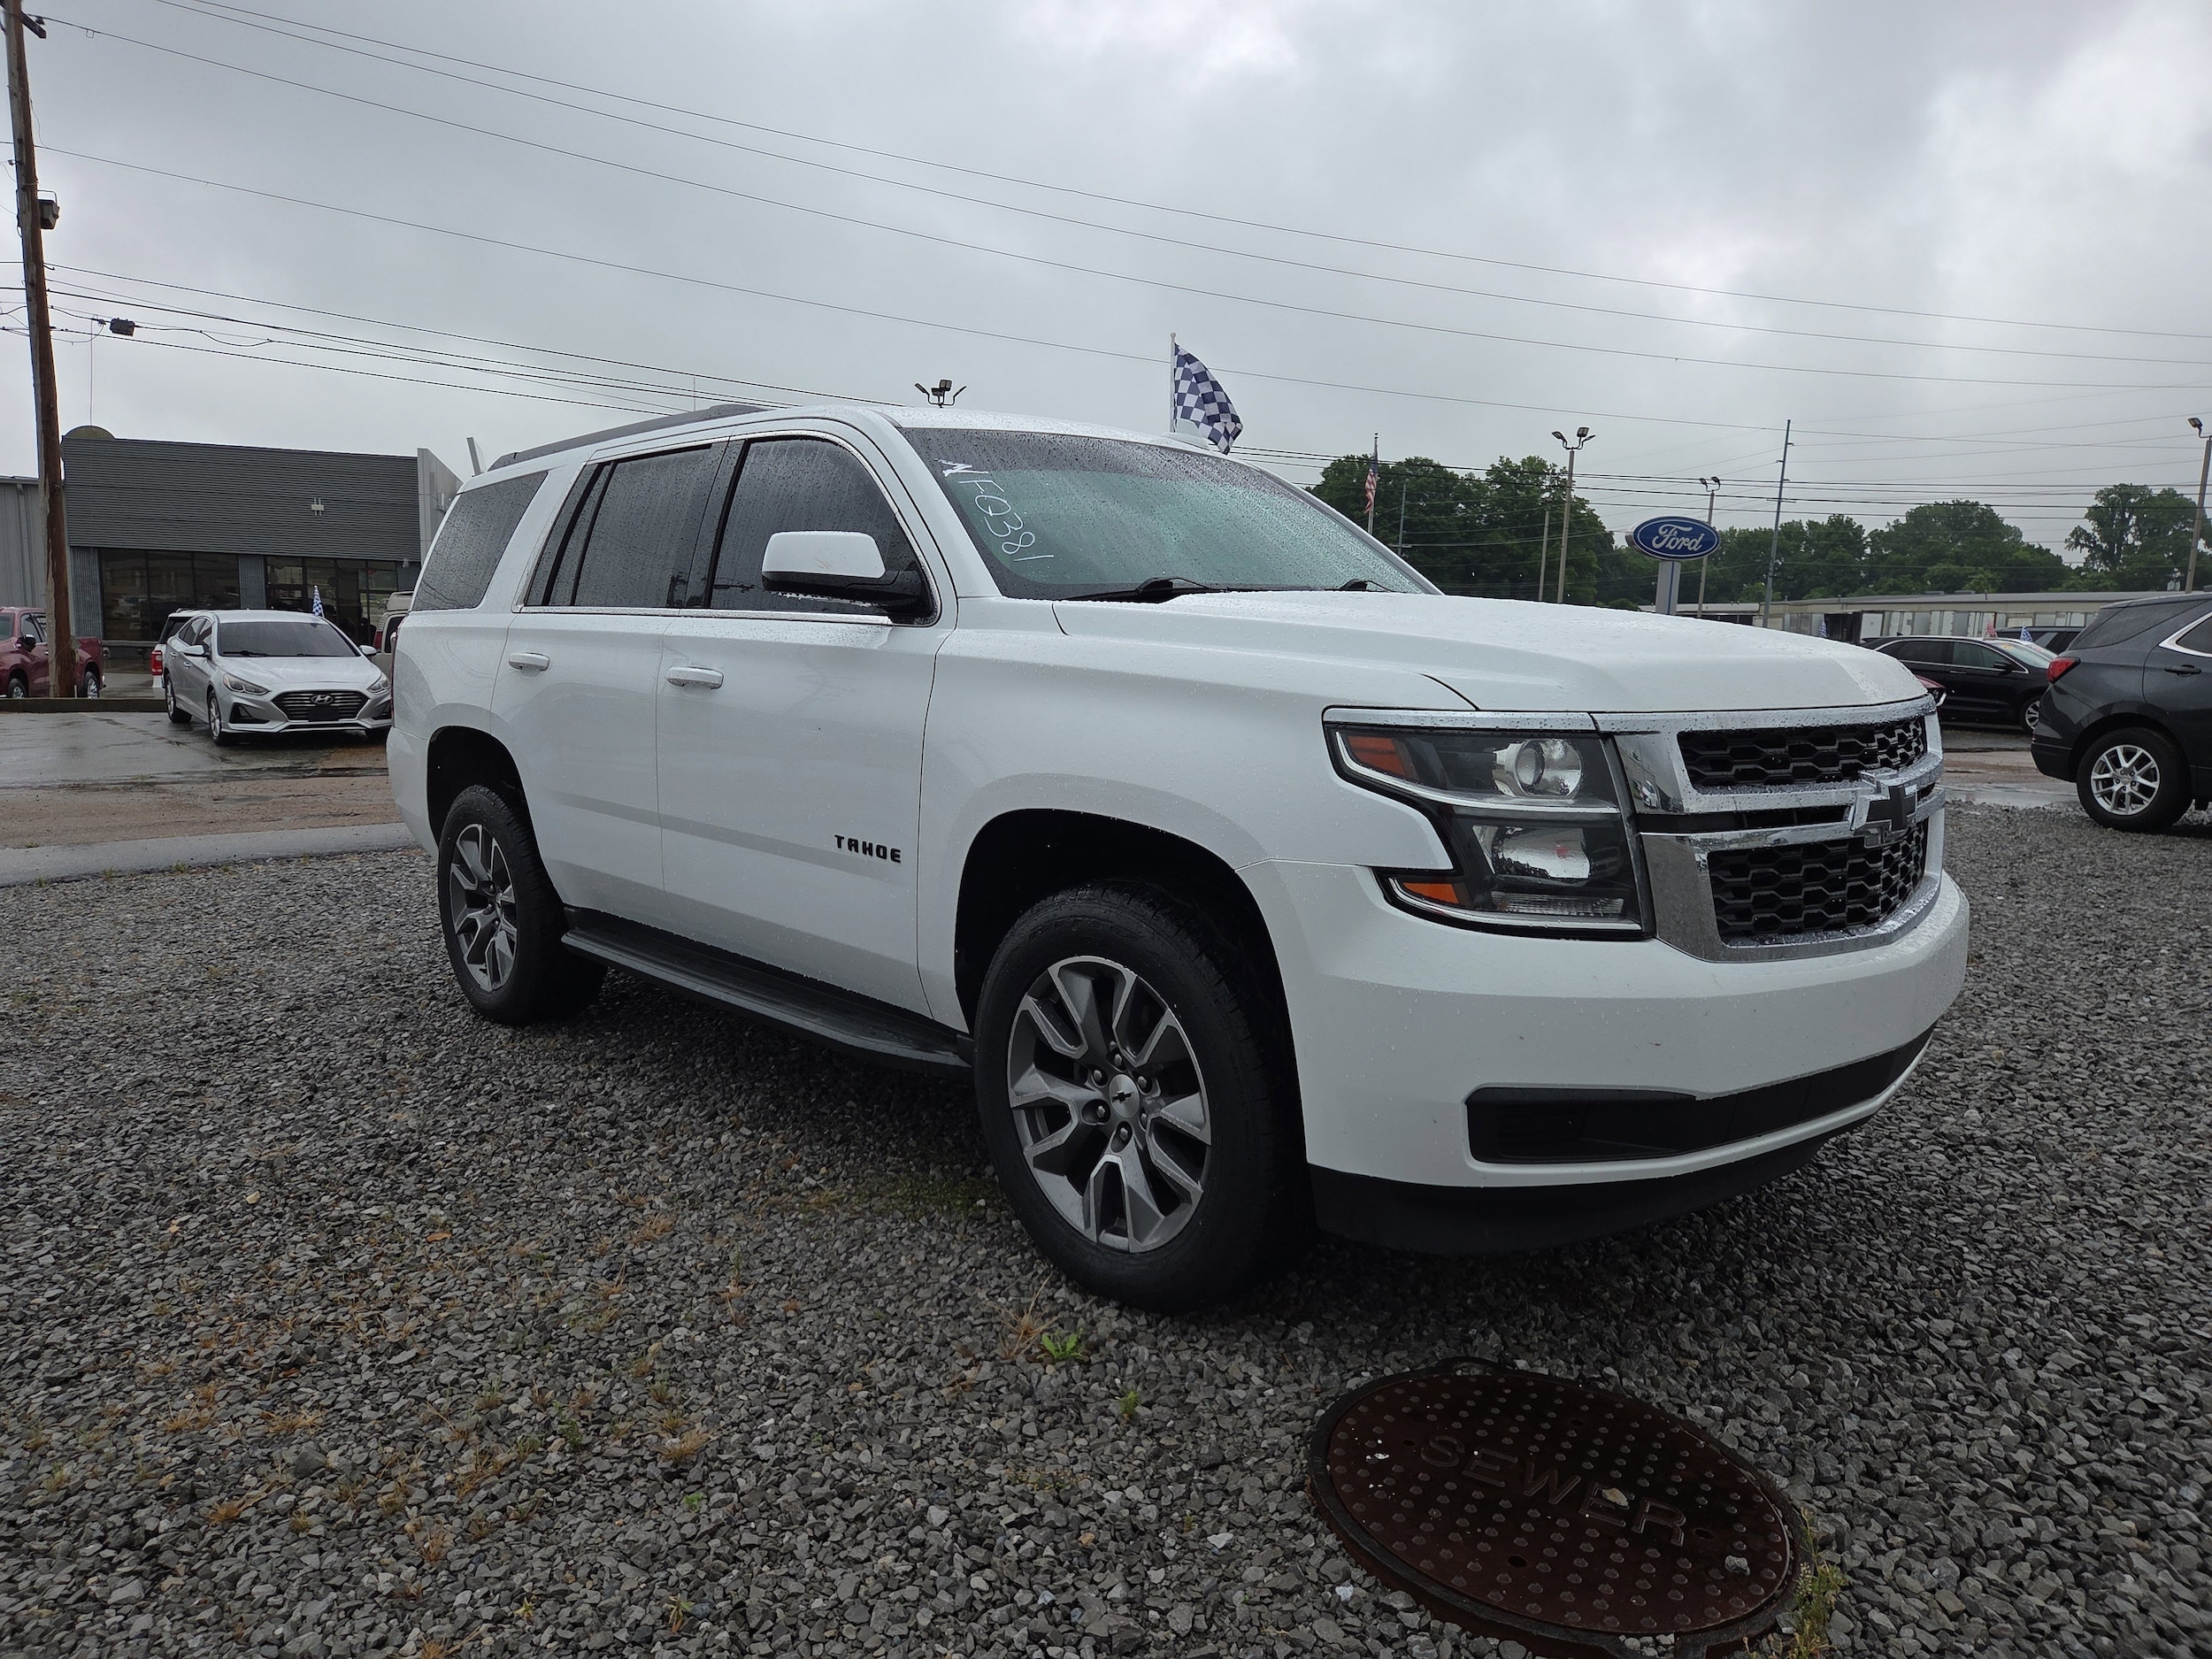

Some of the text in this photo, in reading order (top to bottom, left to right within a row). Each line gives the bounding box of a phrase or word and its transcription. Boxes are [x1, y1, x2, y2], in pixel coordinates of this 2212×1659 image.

[1651, 523, 1704, 551] Ford
[833, 834, 902, 864] TAHOE
[1420, 1434, 1687, 1547] SEWER
